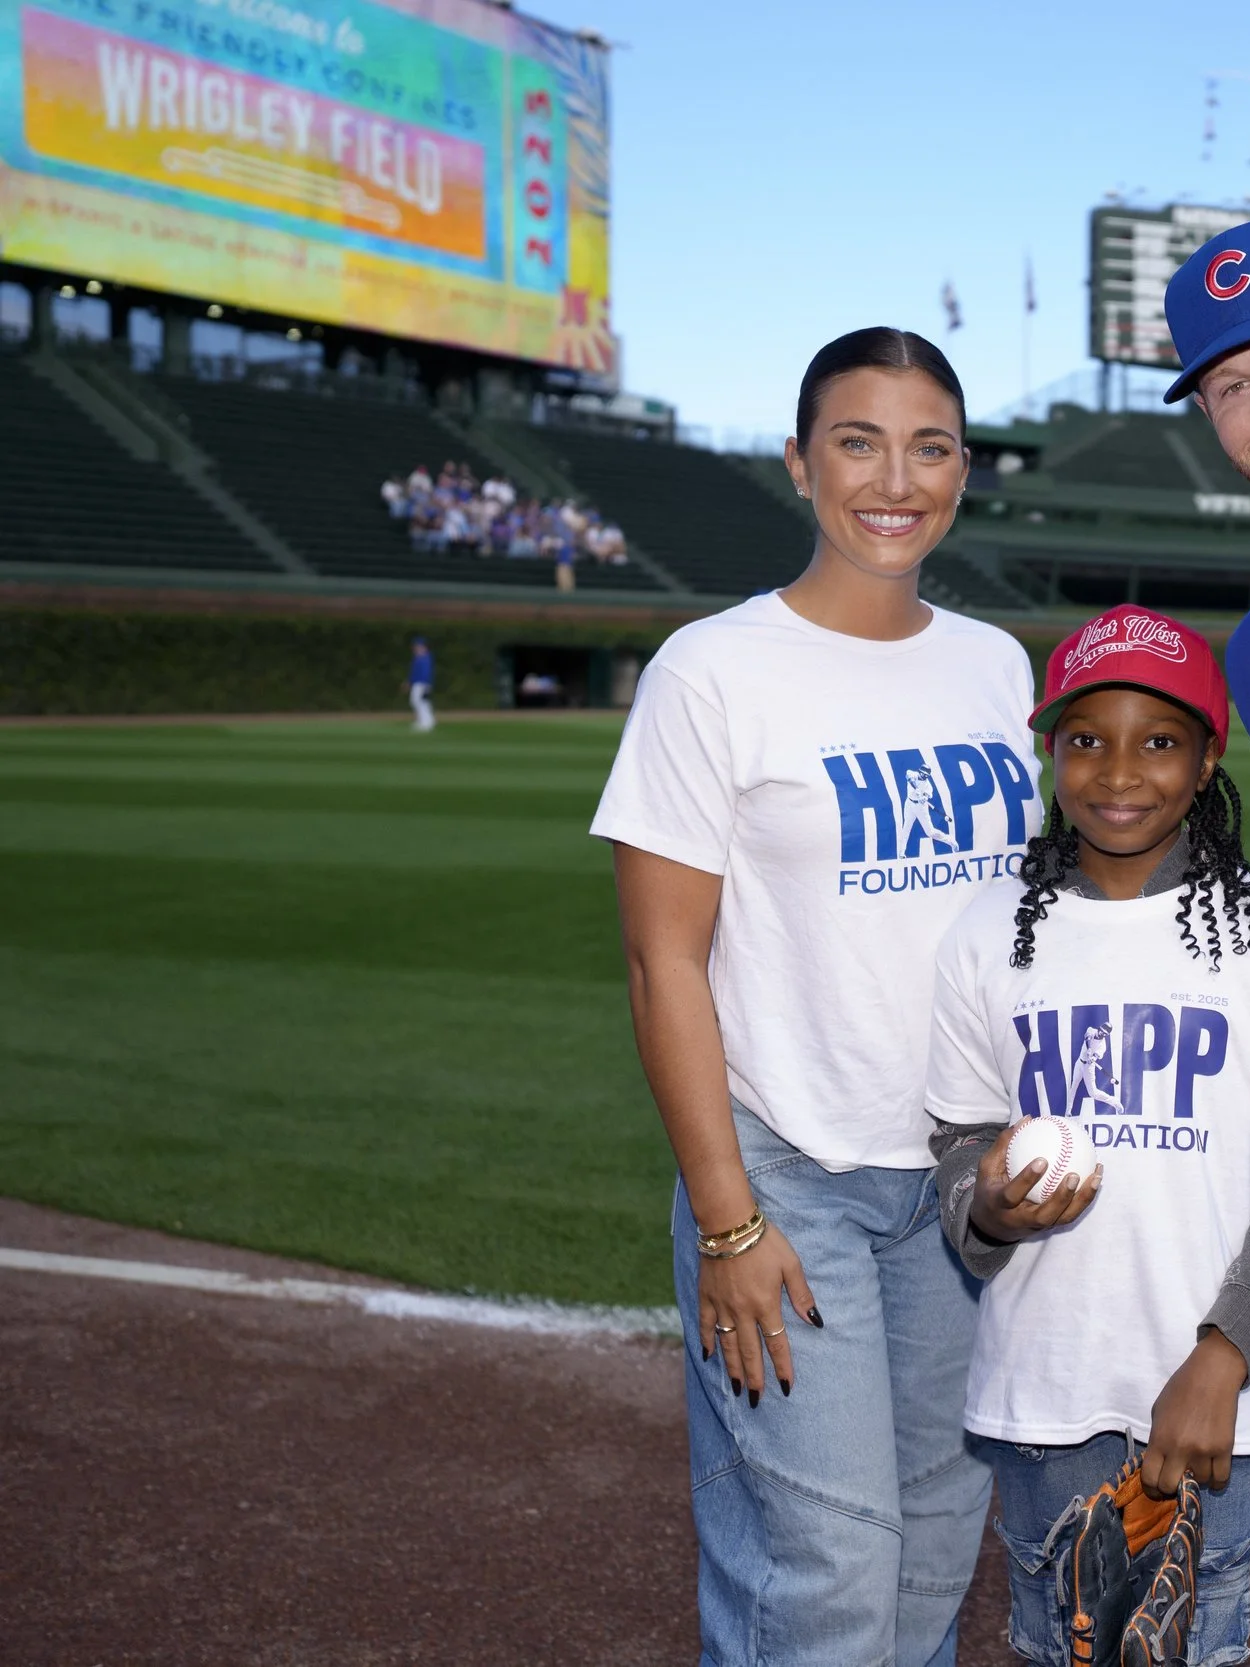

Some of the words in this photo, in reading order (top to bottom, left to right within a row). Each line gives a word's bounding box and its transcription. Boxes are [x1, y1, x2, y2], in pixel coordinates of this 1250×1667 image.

[97, 41, 315, 157] WRIGLEY
[330, 108, 442, 214] FIELD
[822, 742, 1035, 863] HAPP
[838, 852, 1026, 896] FOUNDATIO
[1170, 992, 1195, 1002] est.
[1198, 994, 1229, 1007] 2025
[1012, 1003, 1229, 1118] HAPP
[1084, 1122, 1209, 1154] DATION
